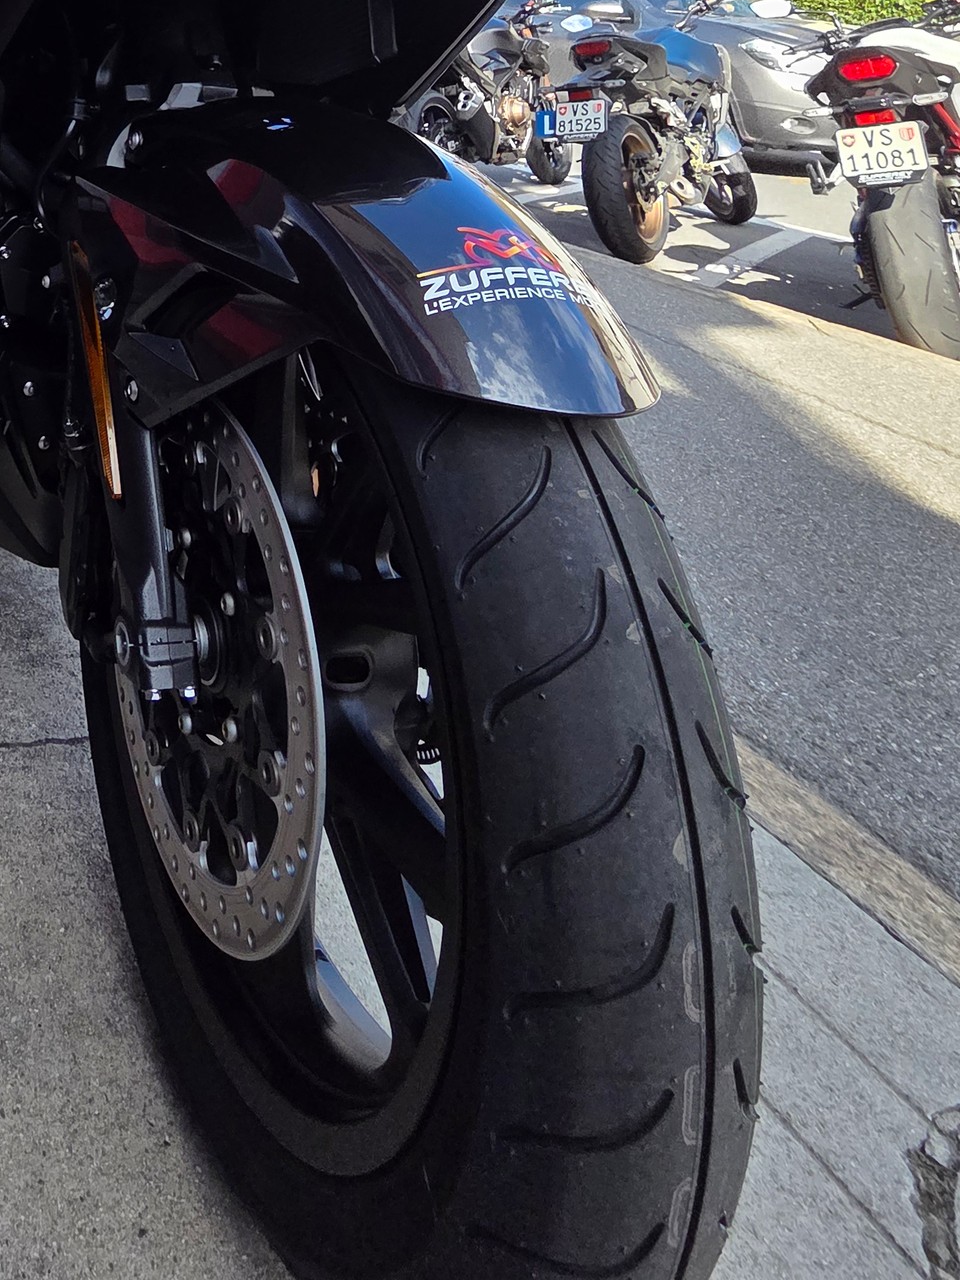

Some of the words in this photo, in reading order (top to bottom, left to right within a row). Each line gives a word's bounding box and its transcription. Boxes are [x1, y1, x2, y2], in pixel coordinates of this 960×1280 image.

[571, 103, 589, 117] VS
[543, 115, 555, 135] L
[558, 117, 602, 133] 81525
[862, 128, 893, 148] VS
[847, 148, 919, 172] 11081
[420, 266, 592, 301] ZUFFERE
[424, 287, 567, 316] L'EXPERIENCE
